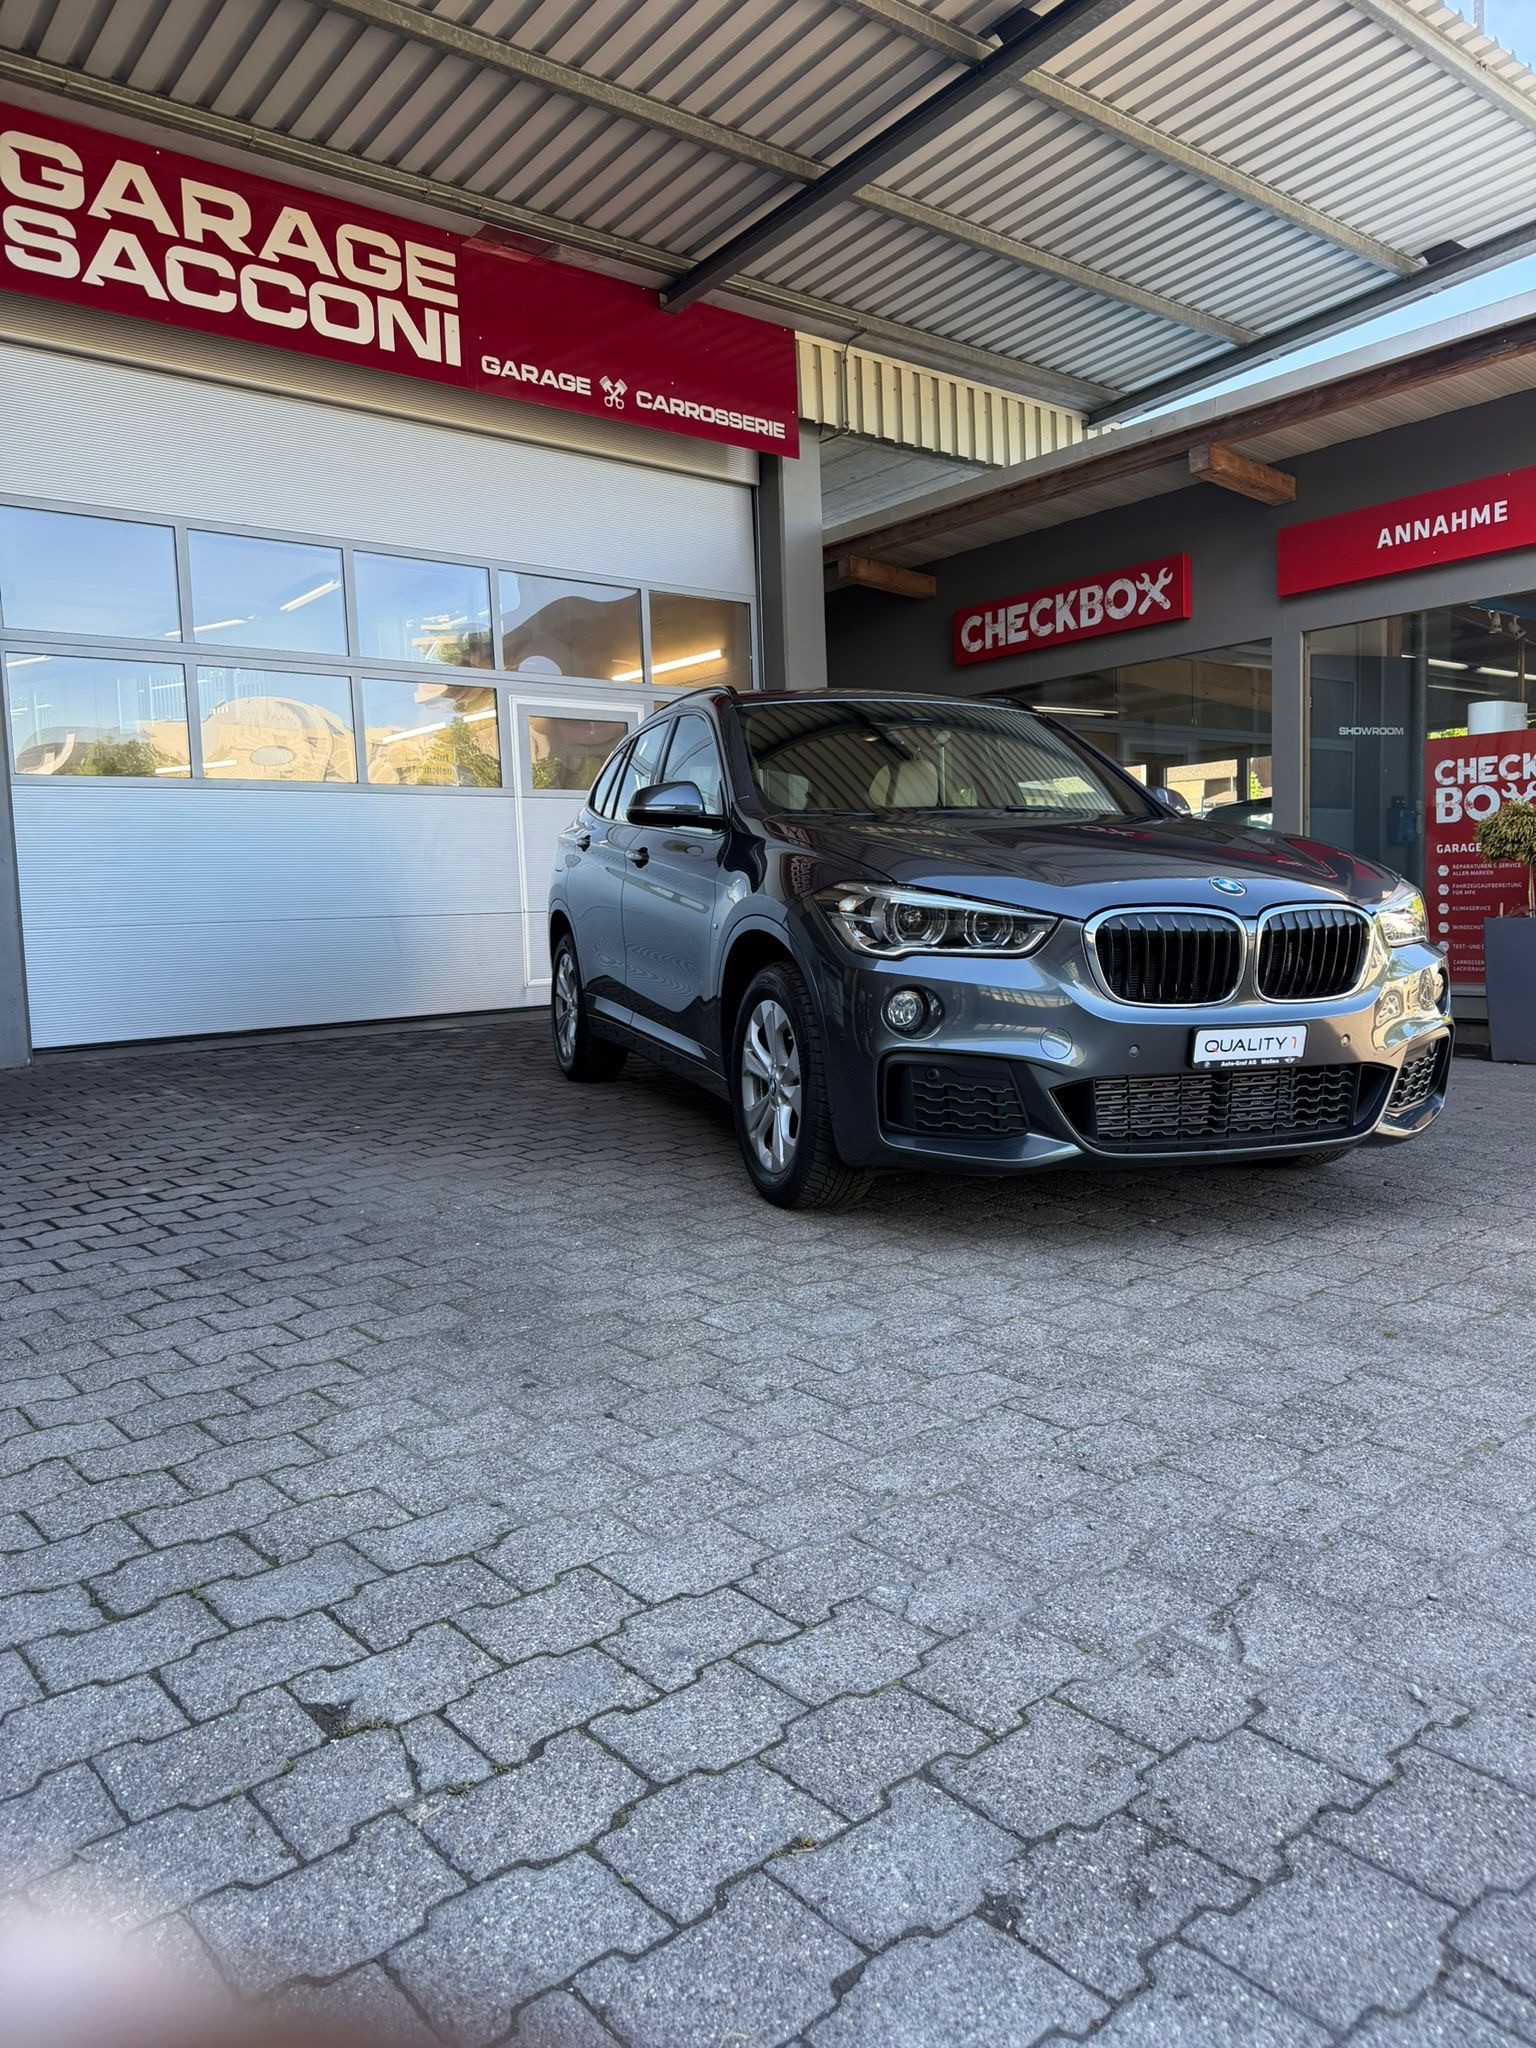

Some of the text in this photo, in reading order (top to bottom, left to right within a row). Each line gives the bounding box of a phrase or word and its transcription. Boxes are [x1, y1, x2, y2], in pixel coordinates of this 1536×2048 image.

[0, 130, 460, 309] GARAGE
[3, 207, 461, 367] SACCONI
[481, 355, 786, 439] GARAGE CARROSSERIE
[1377, 500, 1509, 550] ANNAHME
[1338, 726, 1404, 736] SHOWROOM
[1434, 752, 1536, 786] CHECK
[1436, 842, 1482, 854] GARAGE
[1204, 1035, 1298, 1053] QUALITY 1
